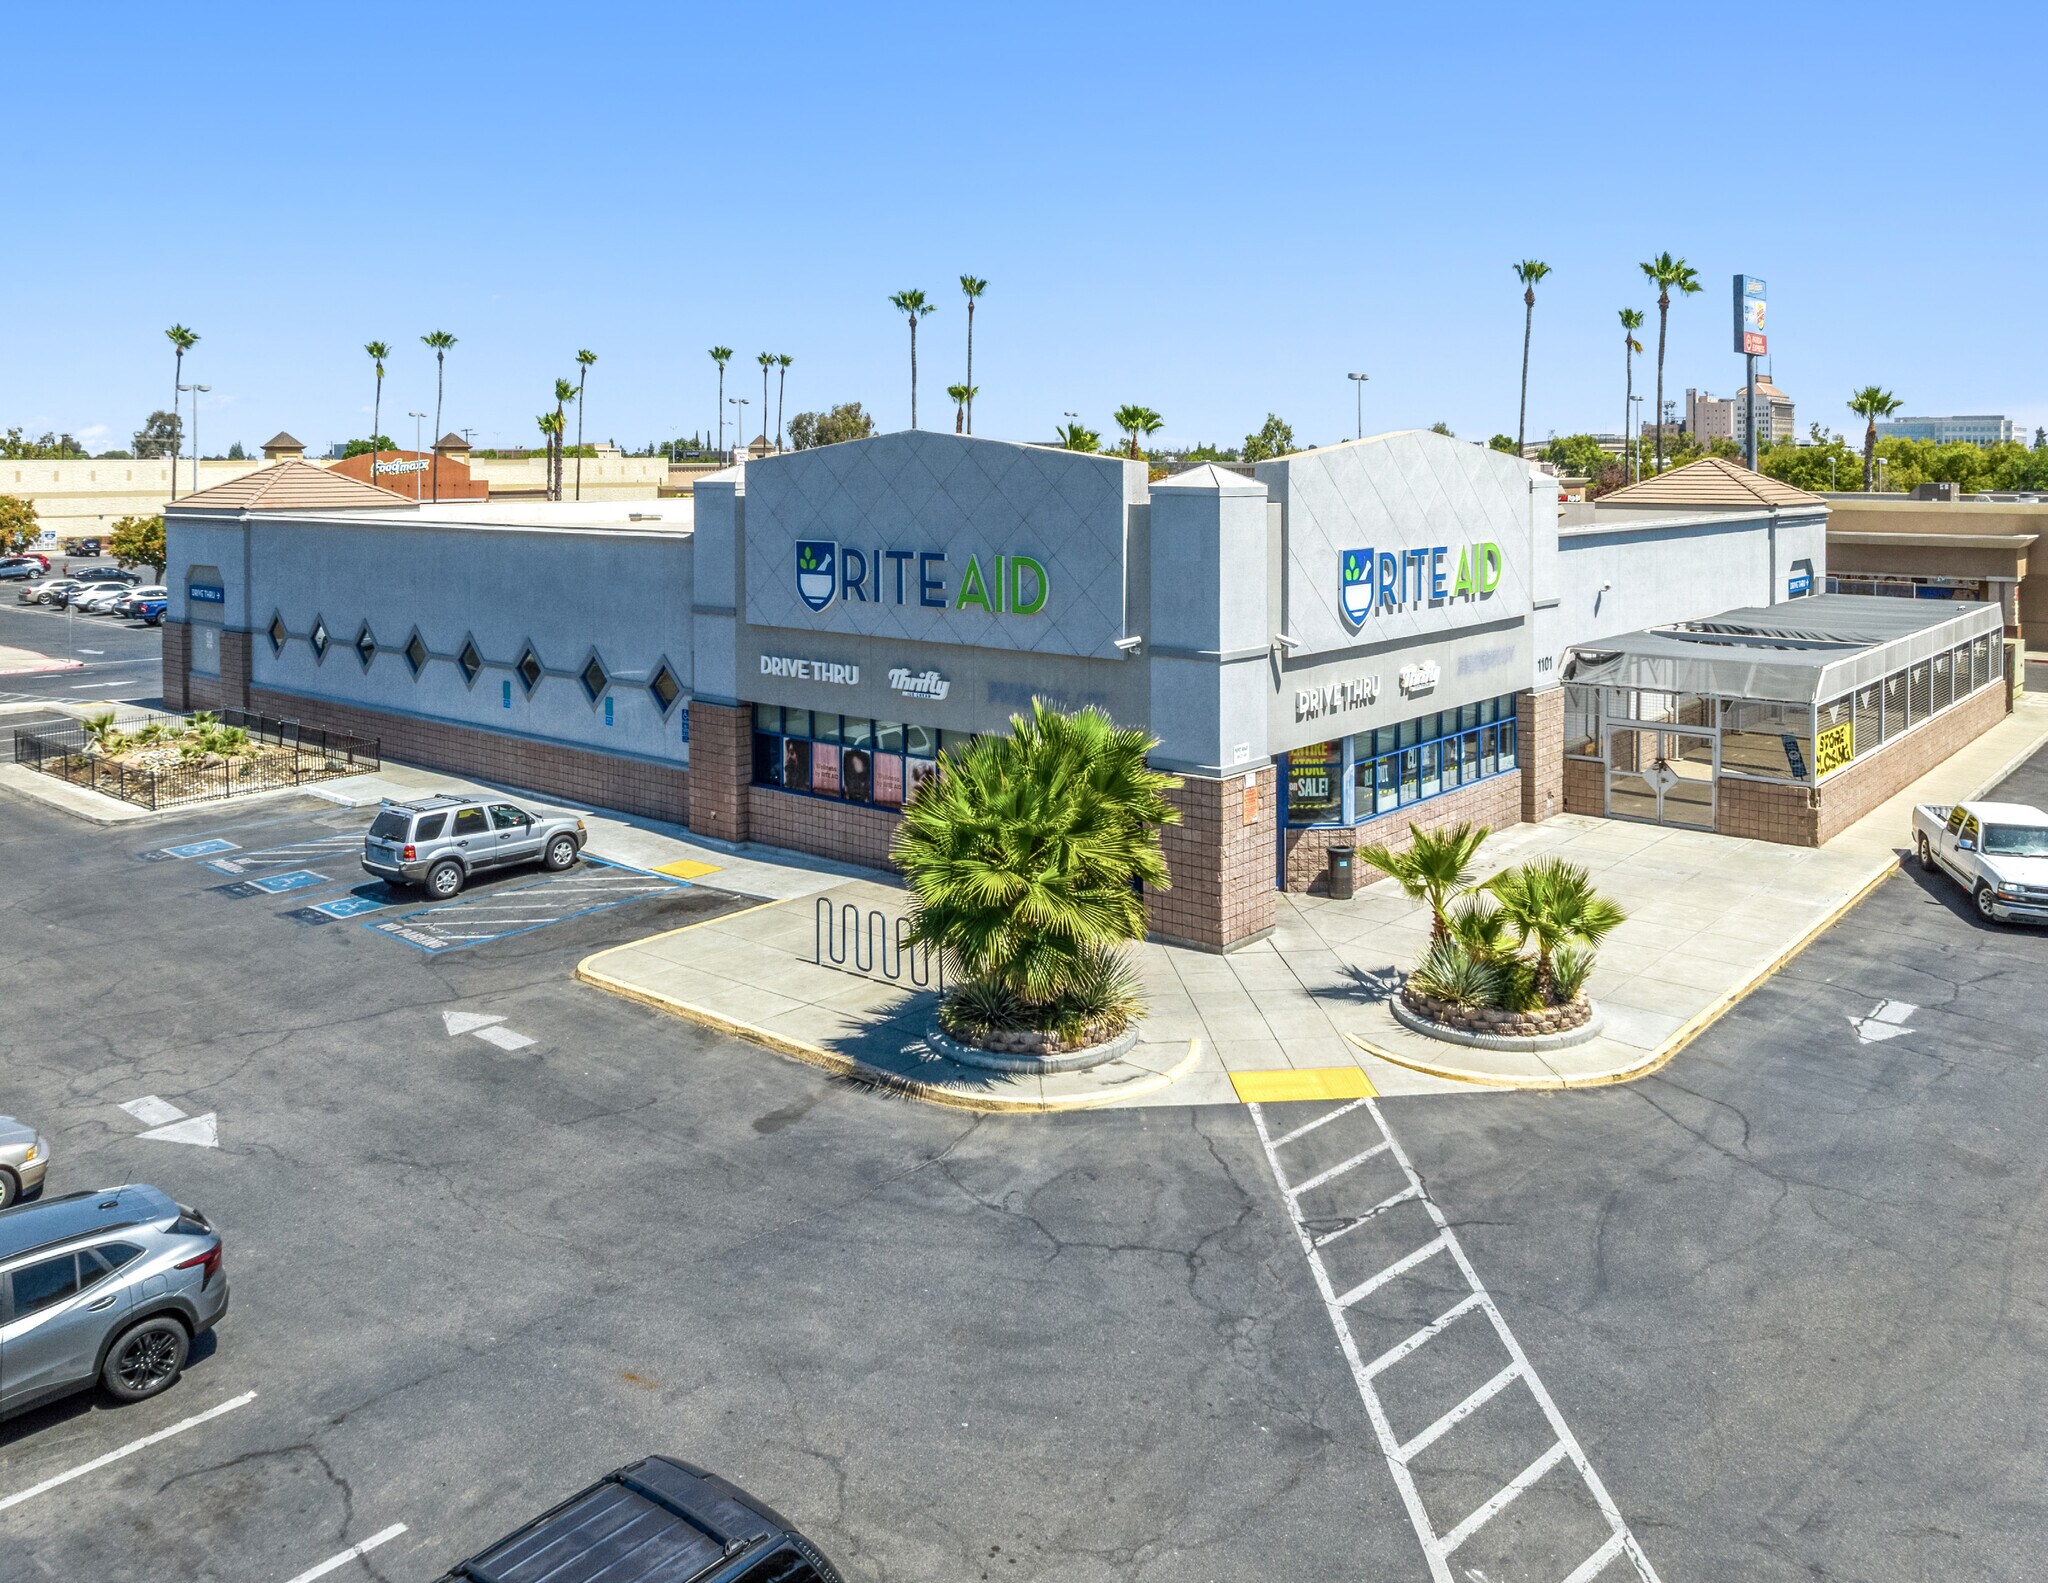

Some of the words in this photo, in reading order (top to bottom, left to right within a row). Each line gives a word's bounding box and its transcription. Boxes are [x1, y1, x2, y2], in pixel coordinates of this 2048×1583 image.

[841, 548, 949, 609] RITE
[955, 553, 1049, 616] AID
[1375, 545, 1448, 608] RITE
[1453, 541, 1503, 599] AID
[760, 655, 811, 680] DRIVE
[810, 661, 860, 686] THRU
[1537, 656, 1552, 672] 1101
[888, 667, 951, 700] Thrifty
[1297, 682, 1342, 714] DRIVE
[1343, 674, 1381, 703] THRU
[1291, 758, 1326, 776] STORE
[1298, 777, 1329, 797] SALE!
